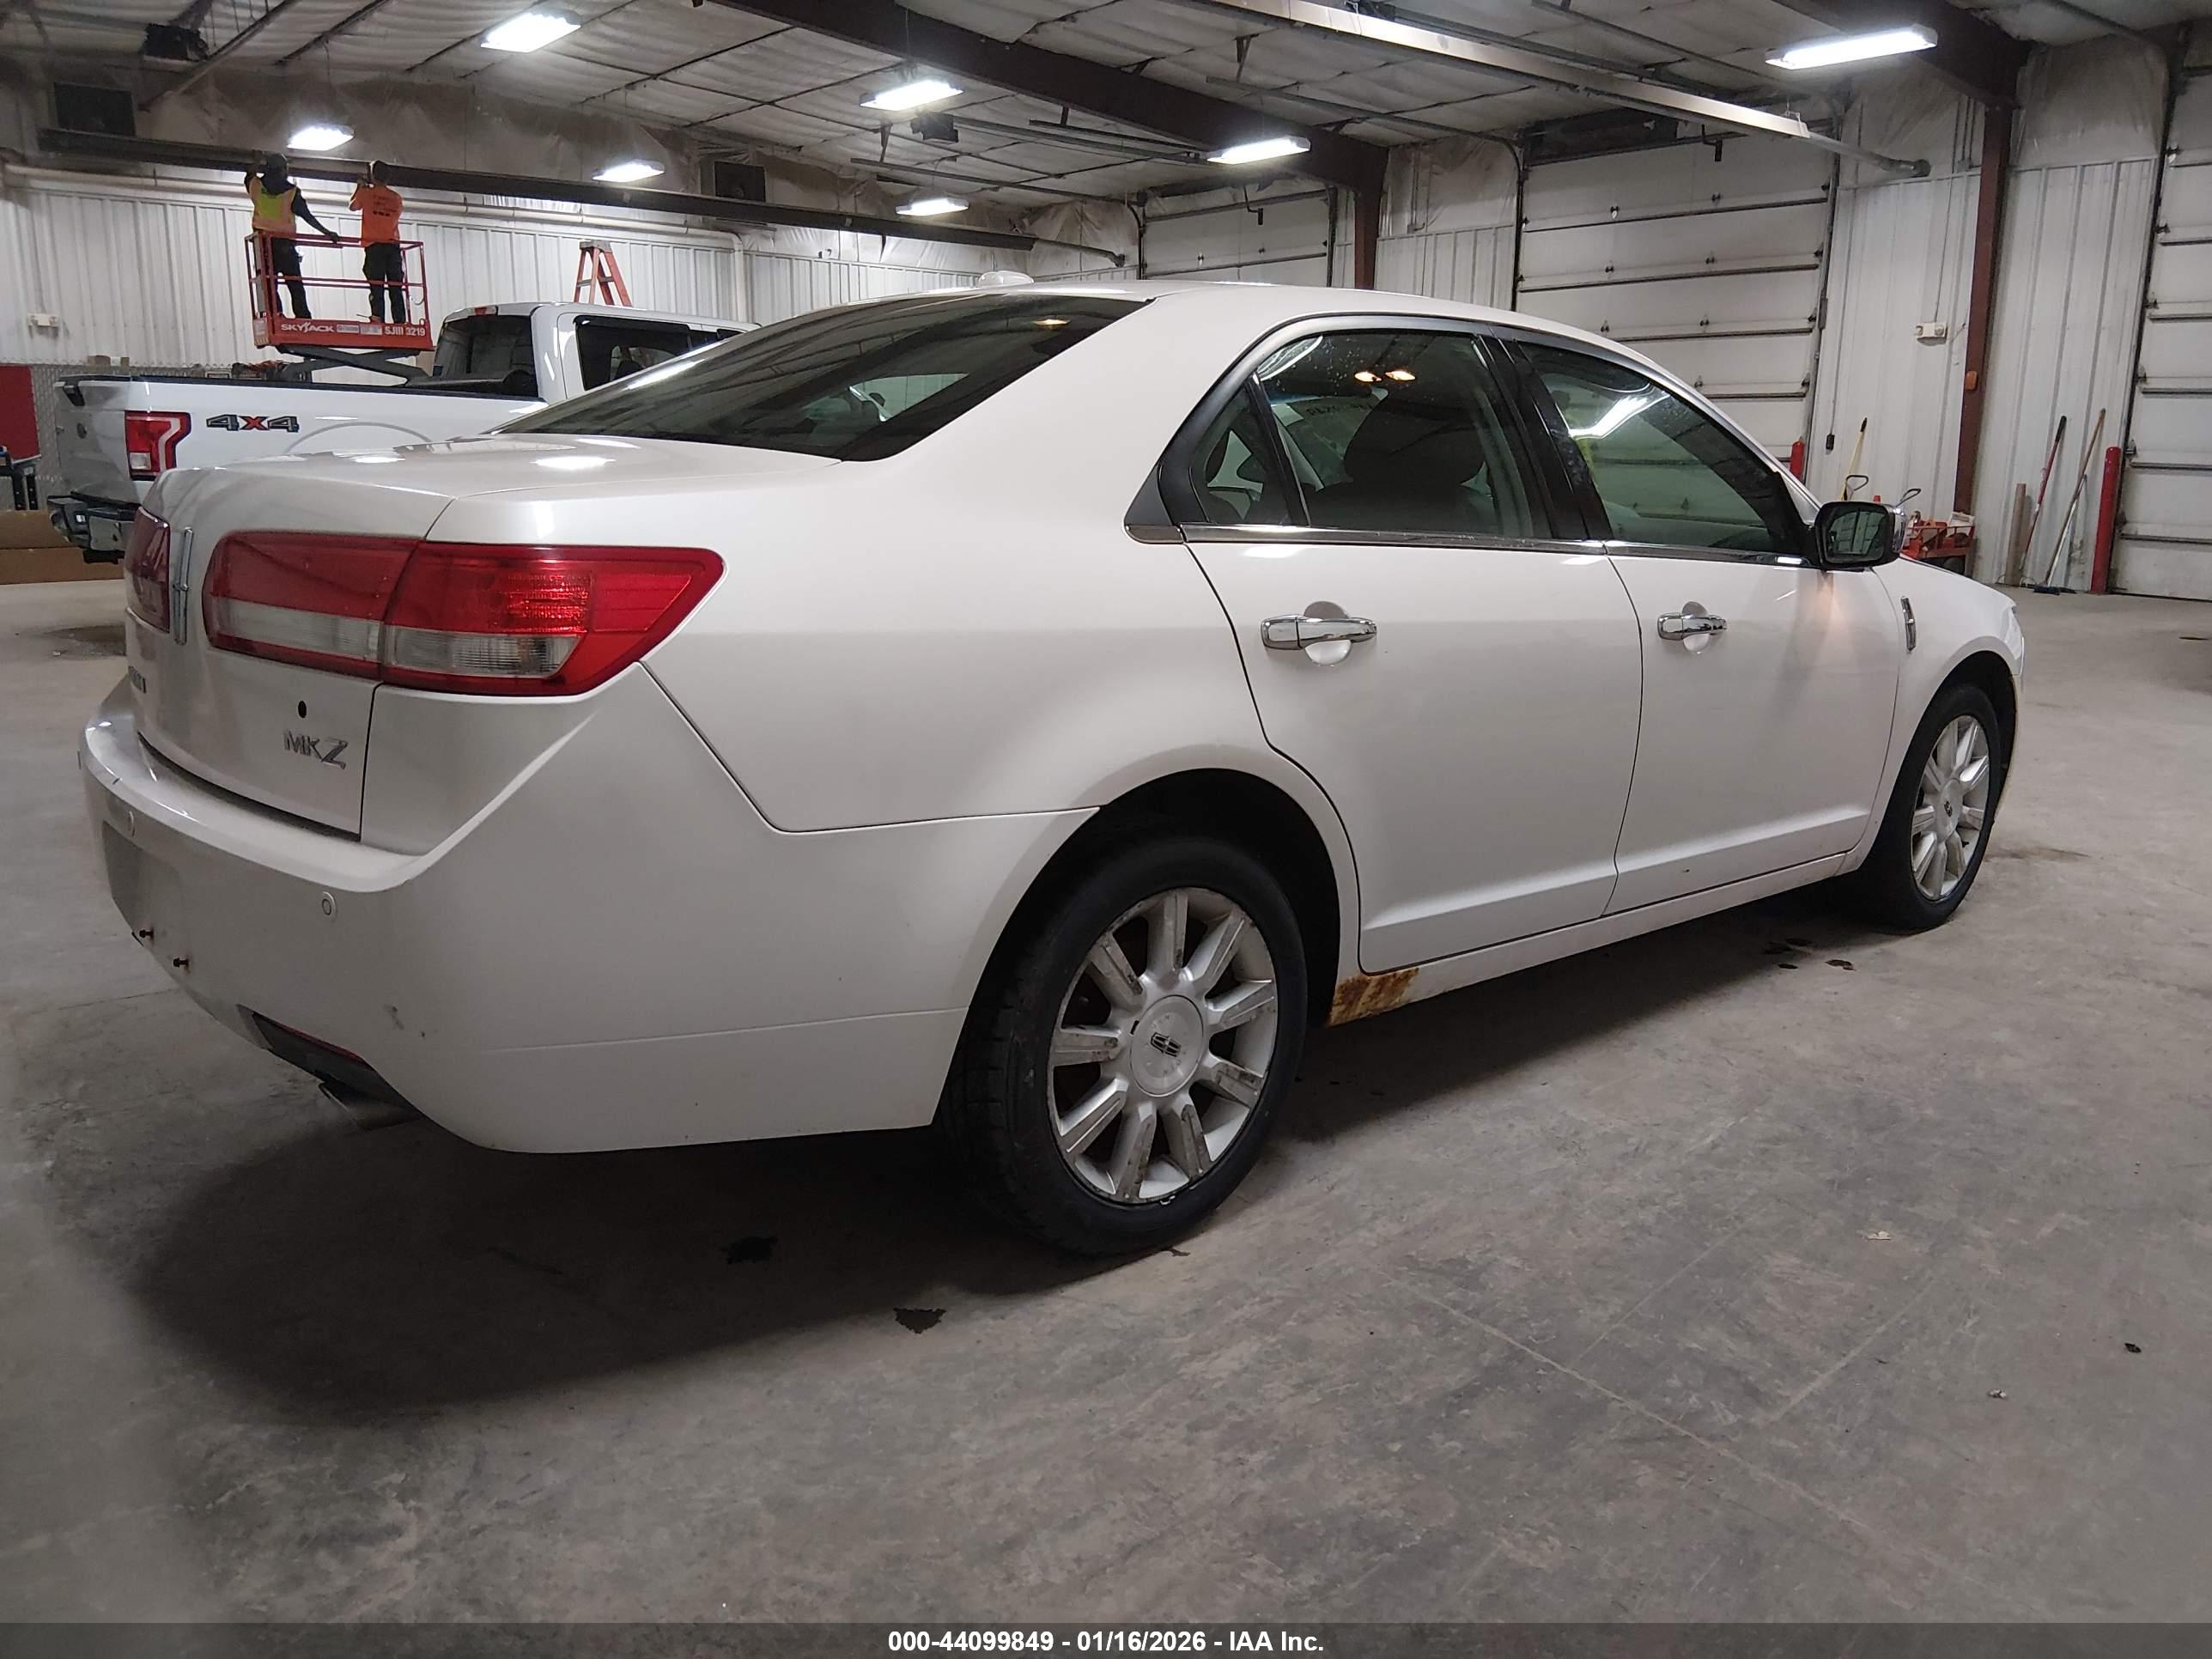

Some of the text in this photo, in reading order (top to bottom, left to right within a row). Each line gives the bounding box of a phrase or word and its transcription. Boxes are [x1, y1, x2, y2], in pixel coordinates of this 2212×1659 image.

[281, 321, 335, 333] SKYJACK
[405, 326, 426, 337] 3219
[283, 728, 349, 770] MKZ
